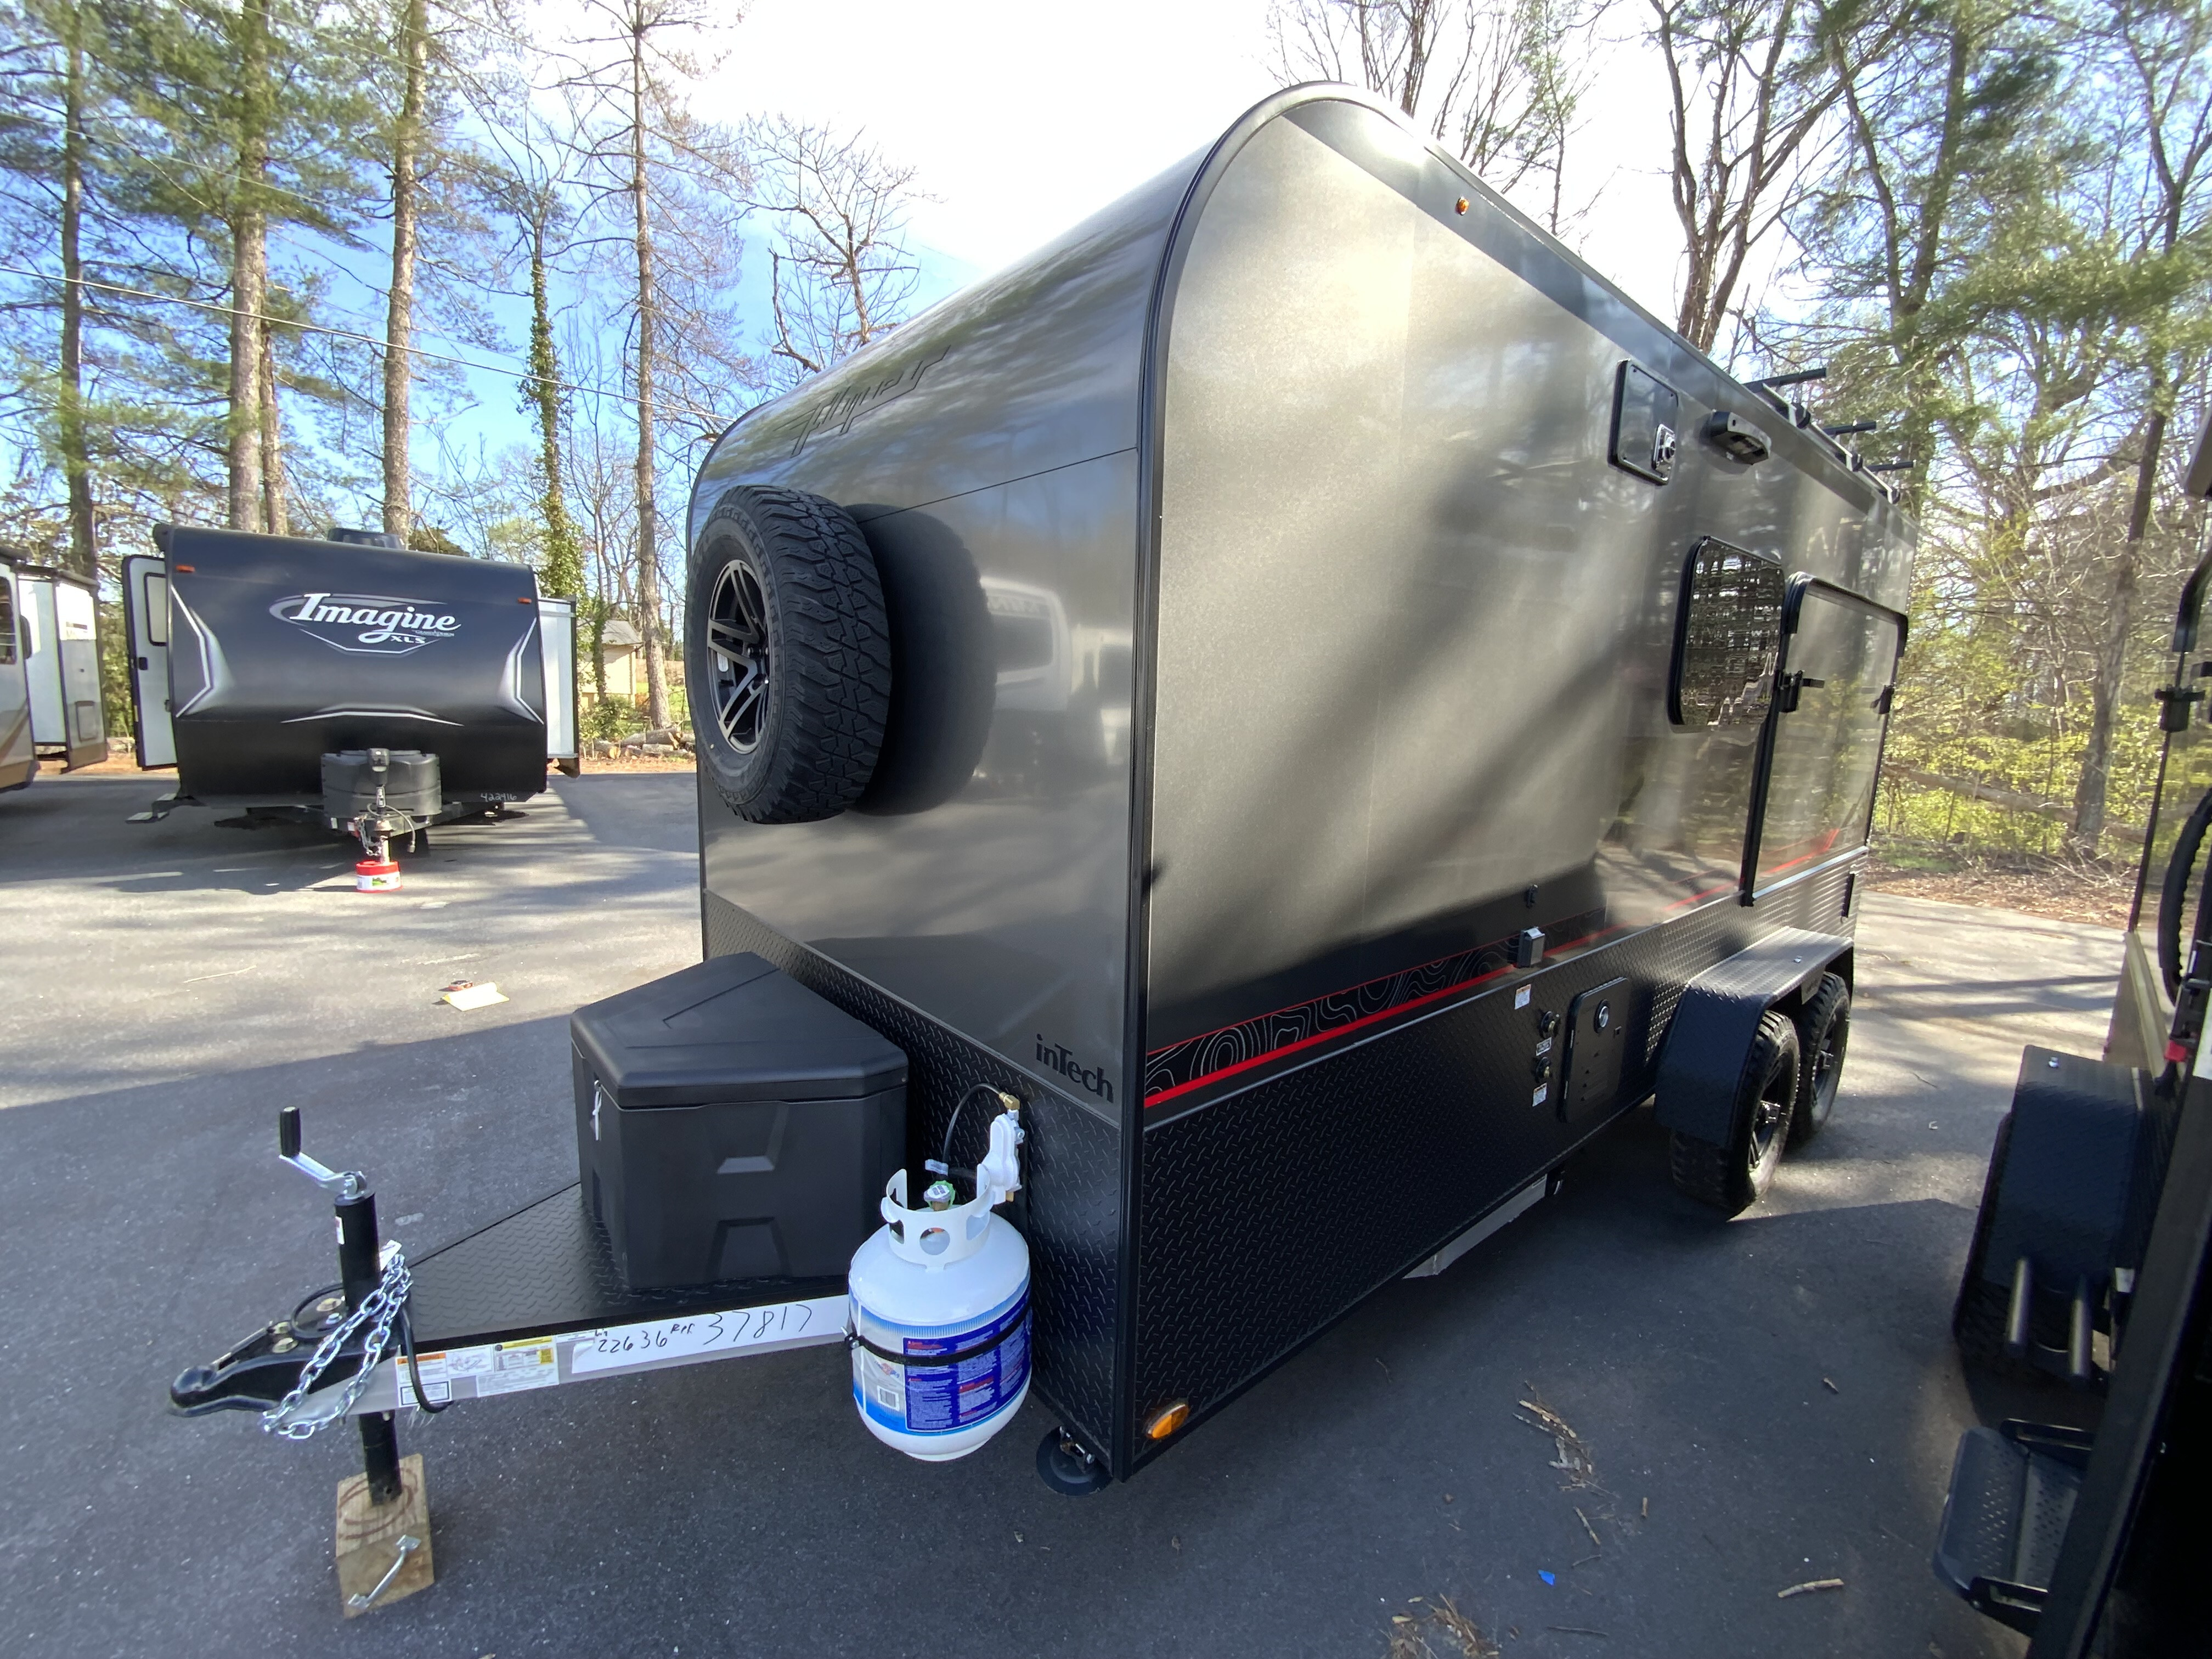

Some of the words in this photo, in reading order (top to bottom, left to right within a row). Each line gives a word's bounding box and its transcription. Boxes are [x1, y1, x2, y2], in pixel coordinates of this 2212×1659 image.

[289, 593, 461, 644] Imagine
[390, 635, 426, 644] XLS
[1036, 1034, 1114, 1103] inTech
[598, 1330, 667, 1353] 22636
[703, 1304, 812, 1345] 37817
